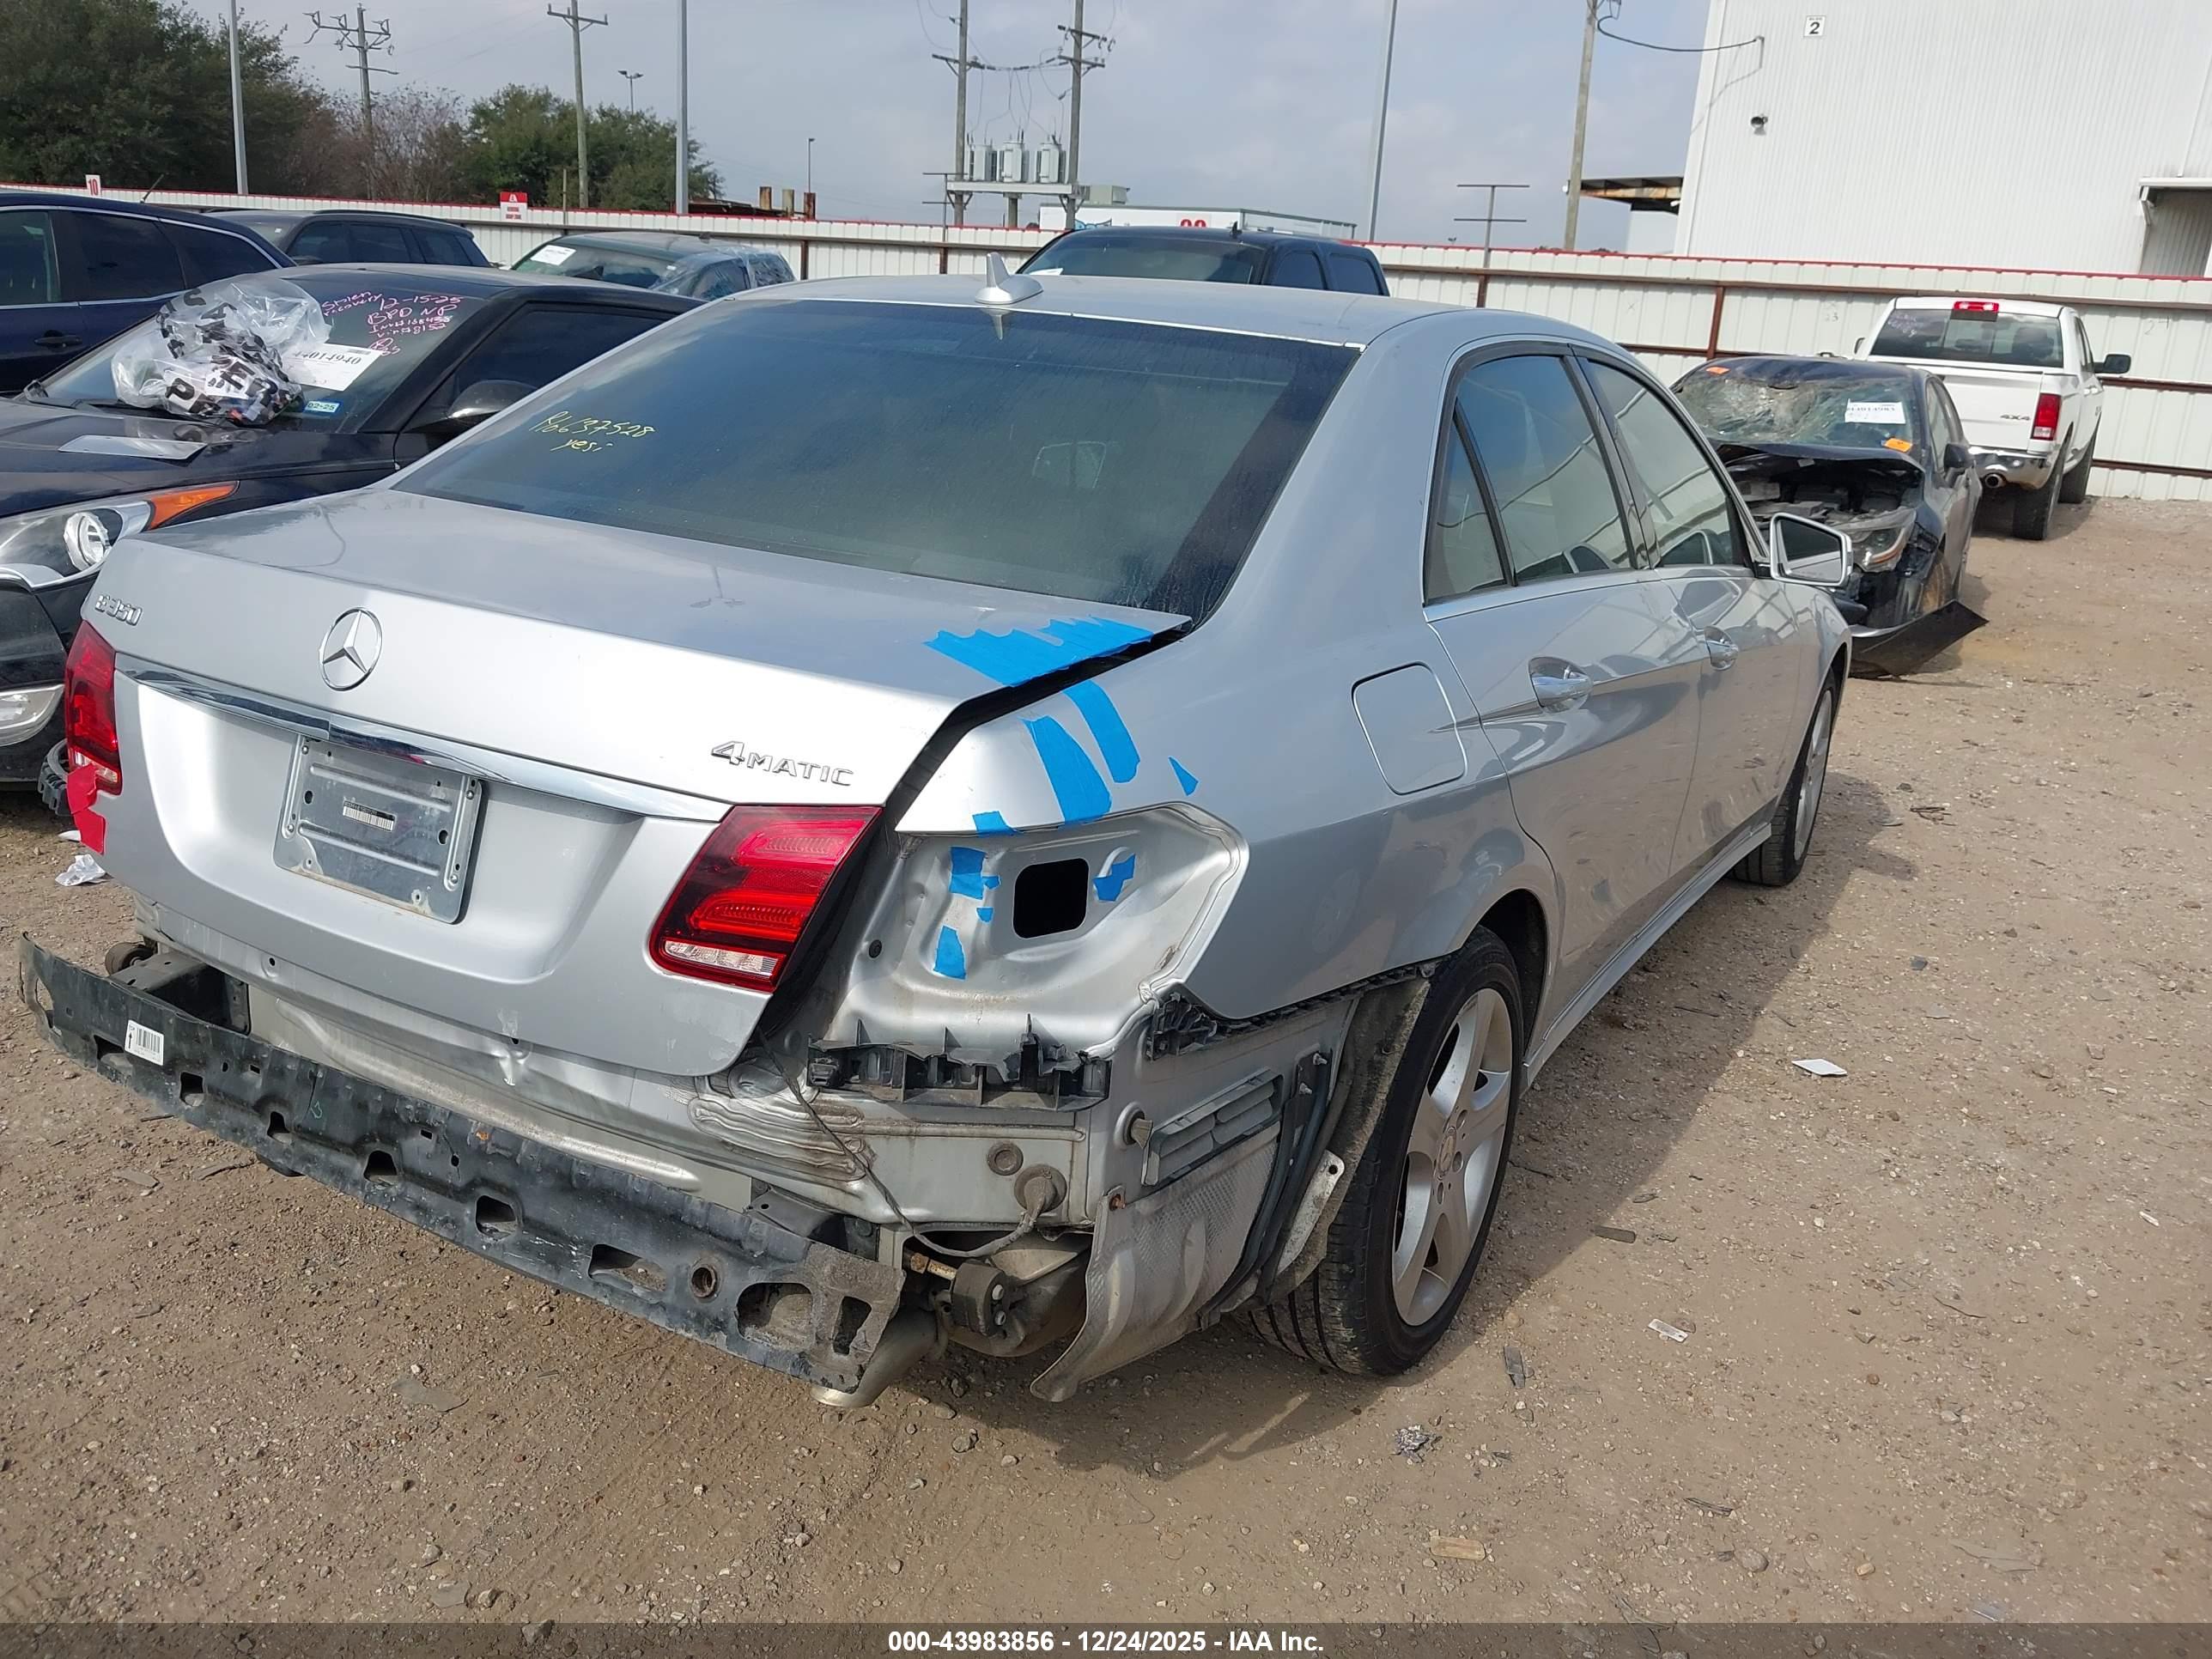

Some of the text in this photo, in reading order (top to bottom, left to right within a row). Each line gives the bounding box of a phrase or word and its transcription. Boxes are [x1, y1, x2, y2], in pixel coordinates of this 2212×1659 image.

[1809, 21, 1820, 35] 2
[88, 179, 99, 196] 10
[368, 307, 412, 325] BPD
[94, 594, 143, 626] E350
[710, 740, 854, 787] 4MATIC
